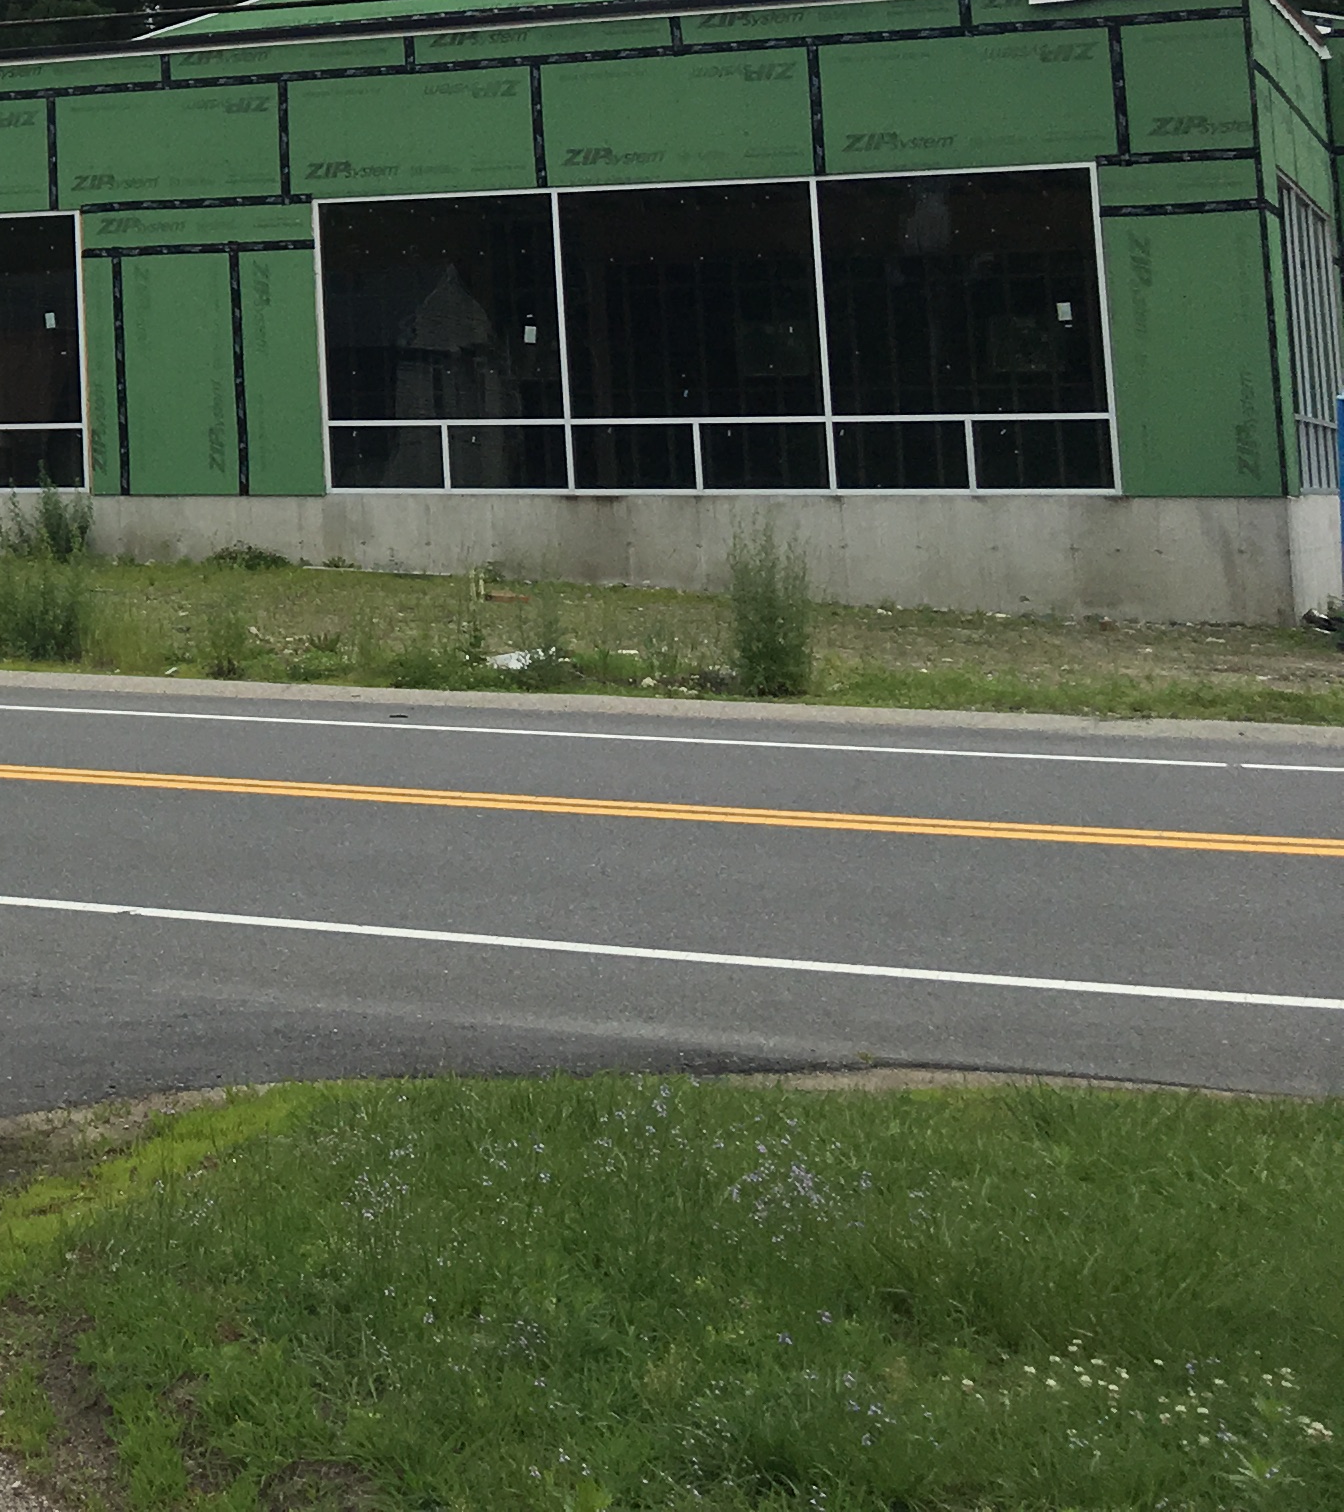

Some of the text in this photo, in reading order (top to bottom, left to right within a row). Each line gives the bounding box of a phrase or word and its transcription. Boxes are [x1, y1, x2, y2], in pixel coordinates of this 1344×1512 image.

[842, 131, 897, 152] ZIP
[562, 147, 612, 166] ZIP
[305, 161, 350, 180] ZIP
